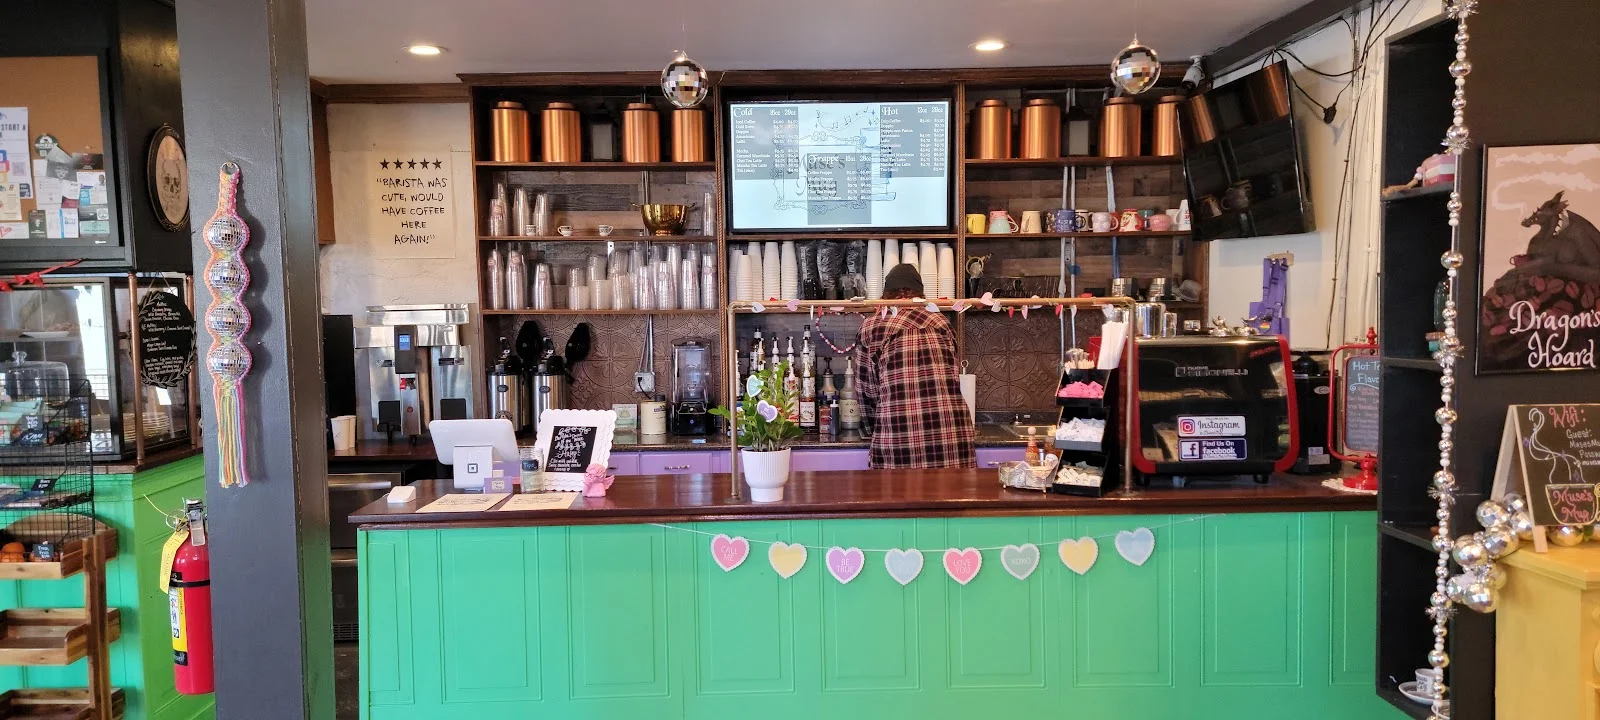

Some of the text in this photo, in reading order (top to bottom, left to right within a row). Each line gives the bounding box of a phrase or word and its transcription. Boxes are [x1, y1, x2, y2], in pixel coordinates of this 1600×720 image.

[733, 107, 754, 118] Cold
[881, 106, 899, 116] Hot
[427, 177, 448, 188] WAS
[381, 193, 444, 202] CUTE, WOULD
[381, 206, 445, 217] HAVE COFFEE
[401, 220, 427, 229] HERE
[1509, 300, 1600, 352] Dragon's
[1527, 330, 1597, 369] Hoard
[1352, 361, 1370, 371] Hot
[1548, 404, 1587, 429] Wifi:
[1197, 420, 1241, 434] Instagram
[1566, 428, 1593, 440] Guest:
[1552, 486, 1594, 507] Muse's
[1561, 503, 1590, 524] Mug
[720, 545, 738, 555] CALL
[723, 553, 735, 562] ME
[841, 558, 851, 566] BE
[953, 558, 972, 567] LOVE
[1010, 557, 1032, 566] XOXO
[836, 565, 855, 574] TRUE
[955, 566, 971, 574] YOU
